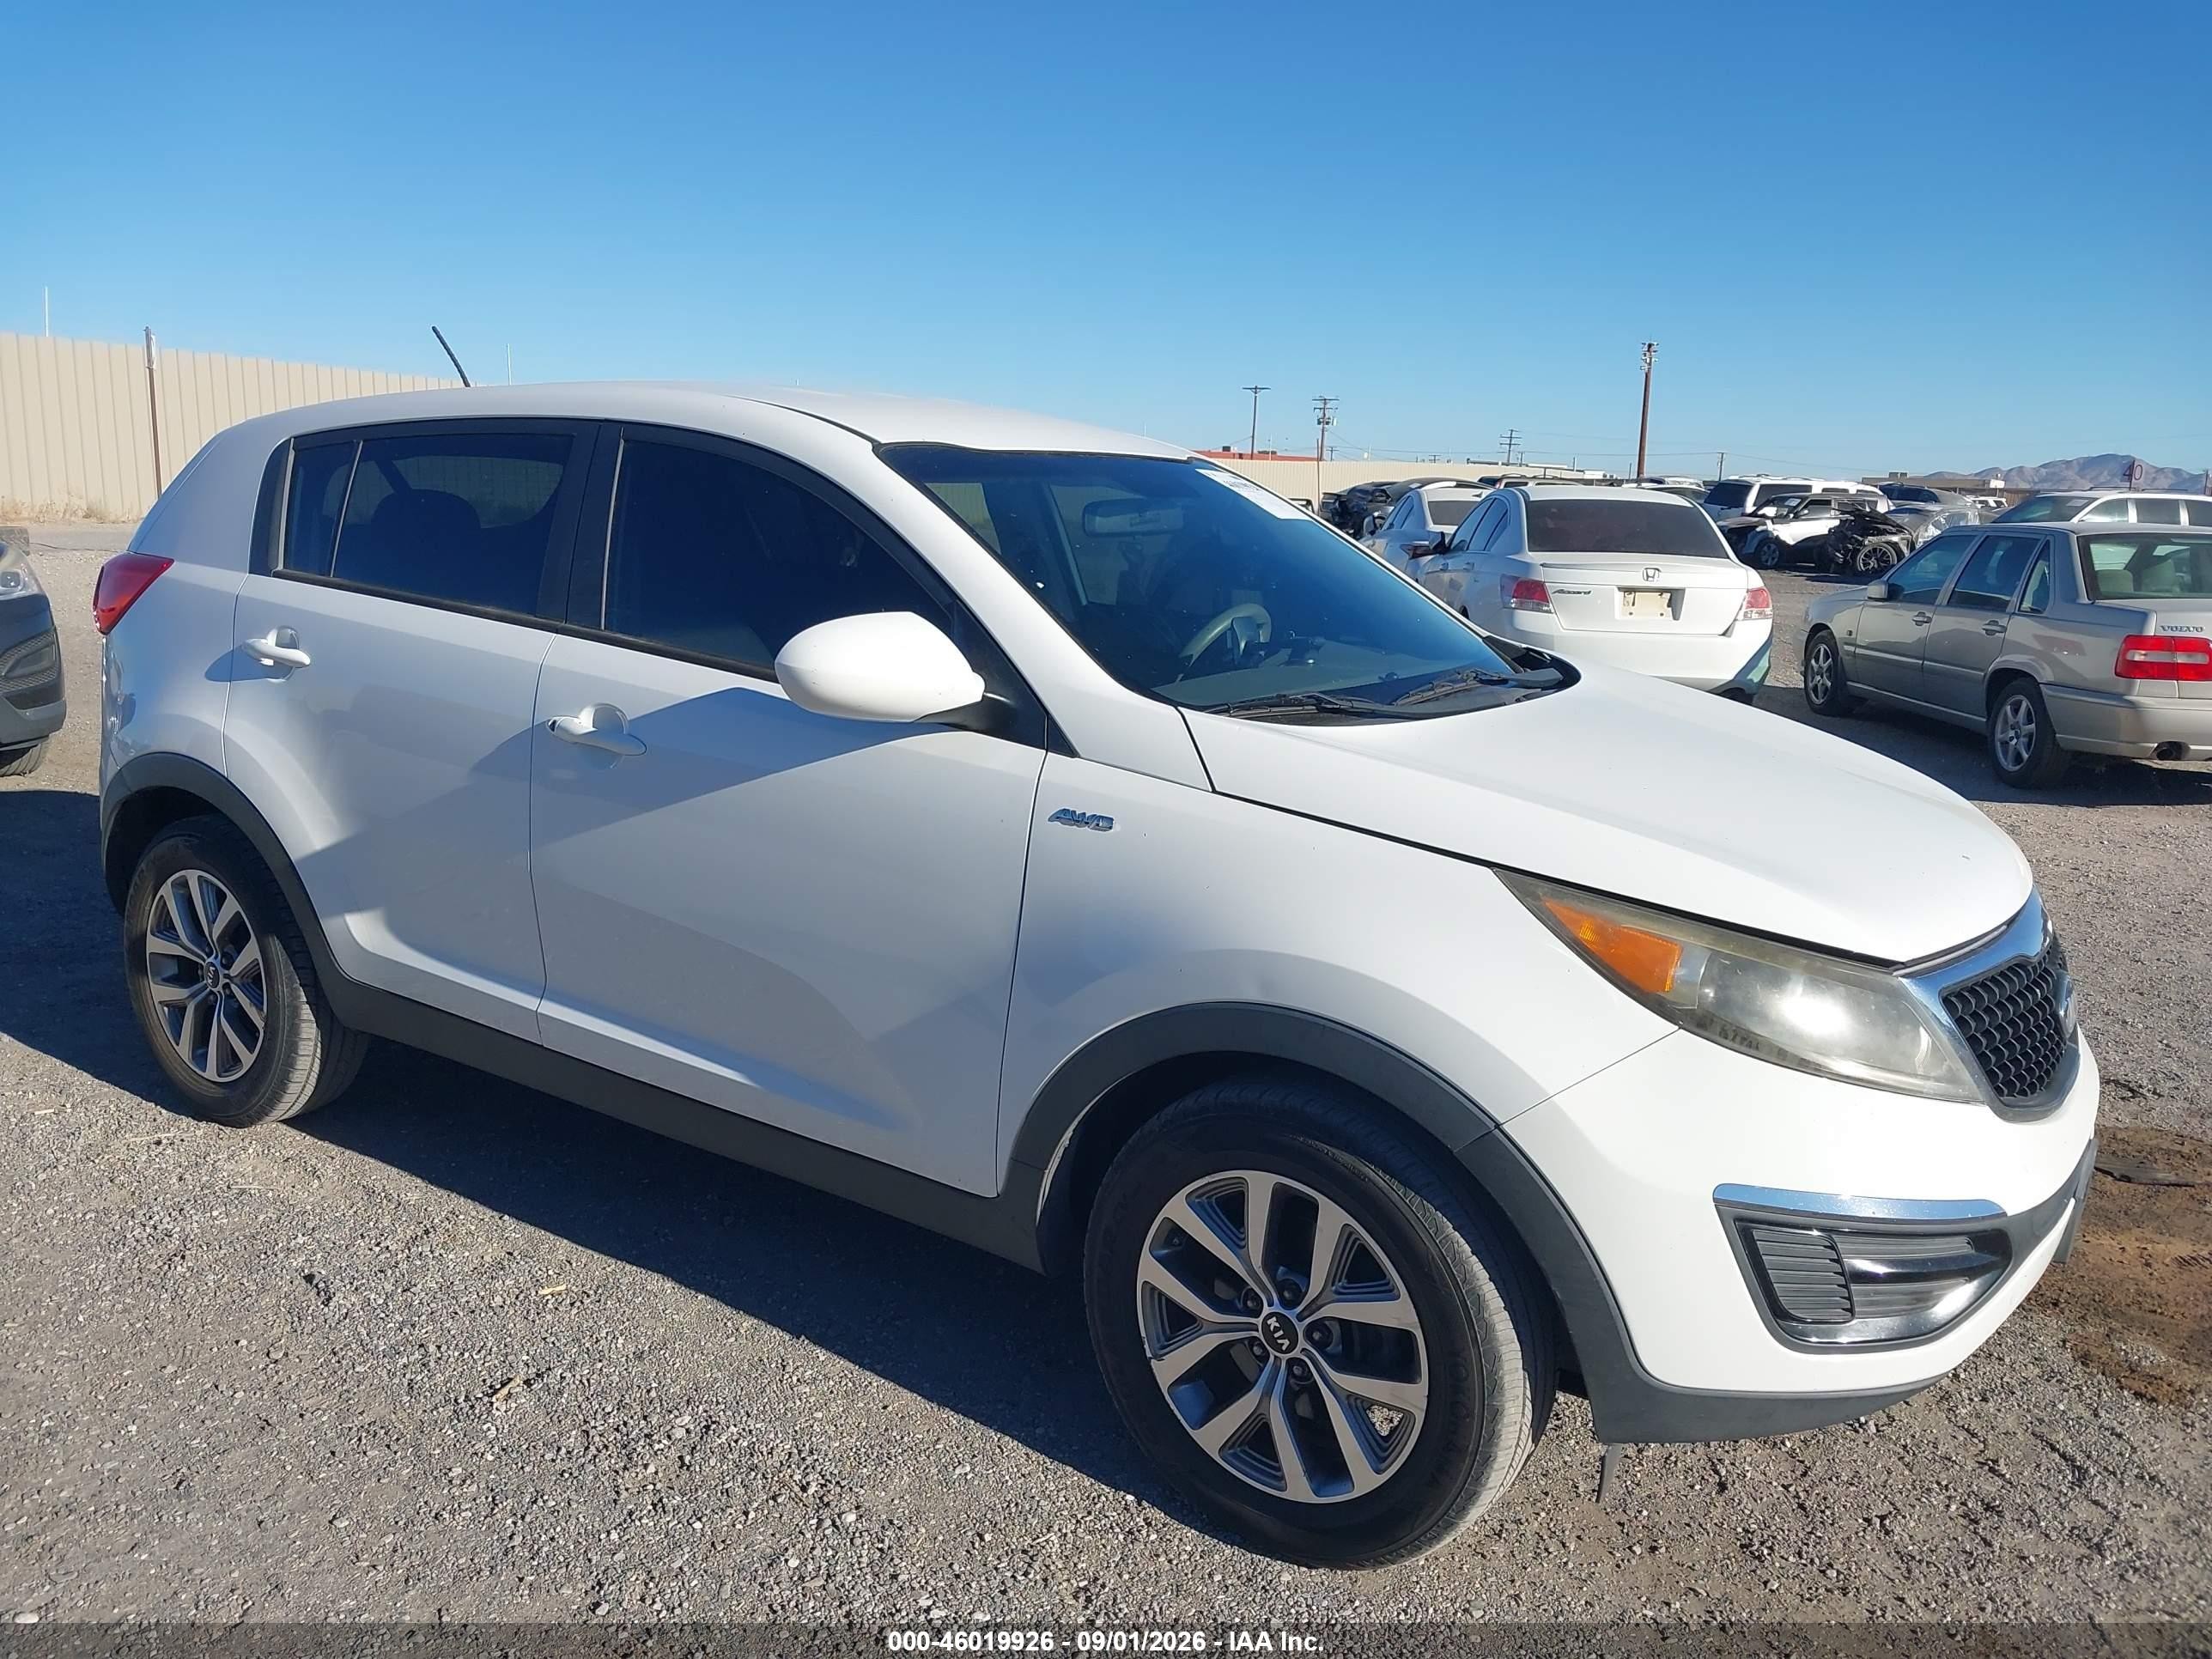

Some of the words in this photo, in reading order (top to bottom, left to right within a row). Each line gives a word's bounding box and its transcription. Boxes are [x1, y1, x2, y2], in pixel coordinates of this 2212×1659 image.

[2123, 464, 2143, 481] 40
[1048, 808, 1115, 832] AWD
[207, 966, 216, 986] KIA
[1267, 1316, 1291, 1351] KIA
